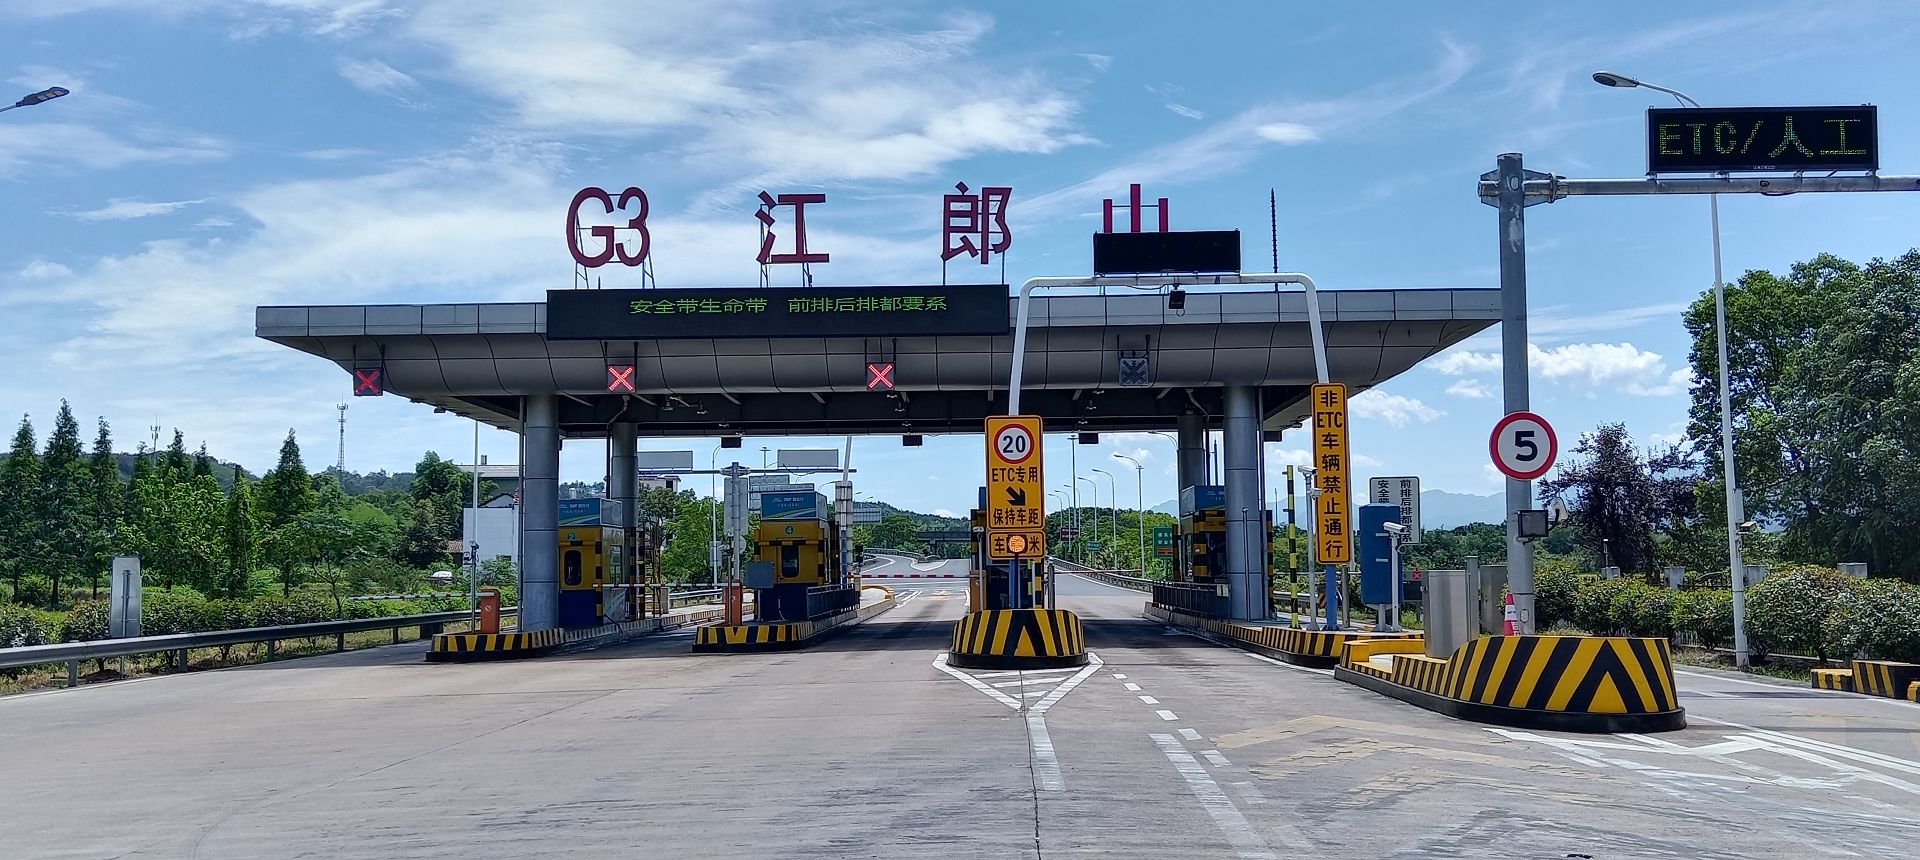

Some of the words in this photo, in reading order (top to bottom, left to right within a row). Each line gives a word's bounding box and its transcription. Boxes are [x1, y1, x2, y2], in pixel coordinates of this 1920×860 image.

[1658, 115, 1867, 158] ETC/人工
[565, 186, 651, 268] G3
[629, 298, 768, 315] 安全带生命带
[788, 296, 947, 313] 前排后排都要系
[1002, 435, 1026, 454] 20
[1515, 430, 1538, 462] 5
[991, 466, 1038, 483] ETC专用
[993, 507, 1039, 525] 保持车距
